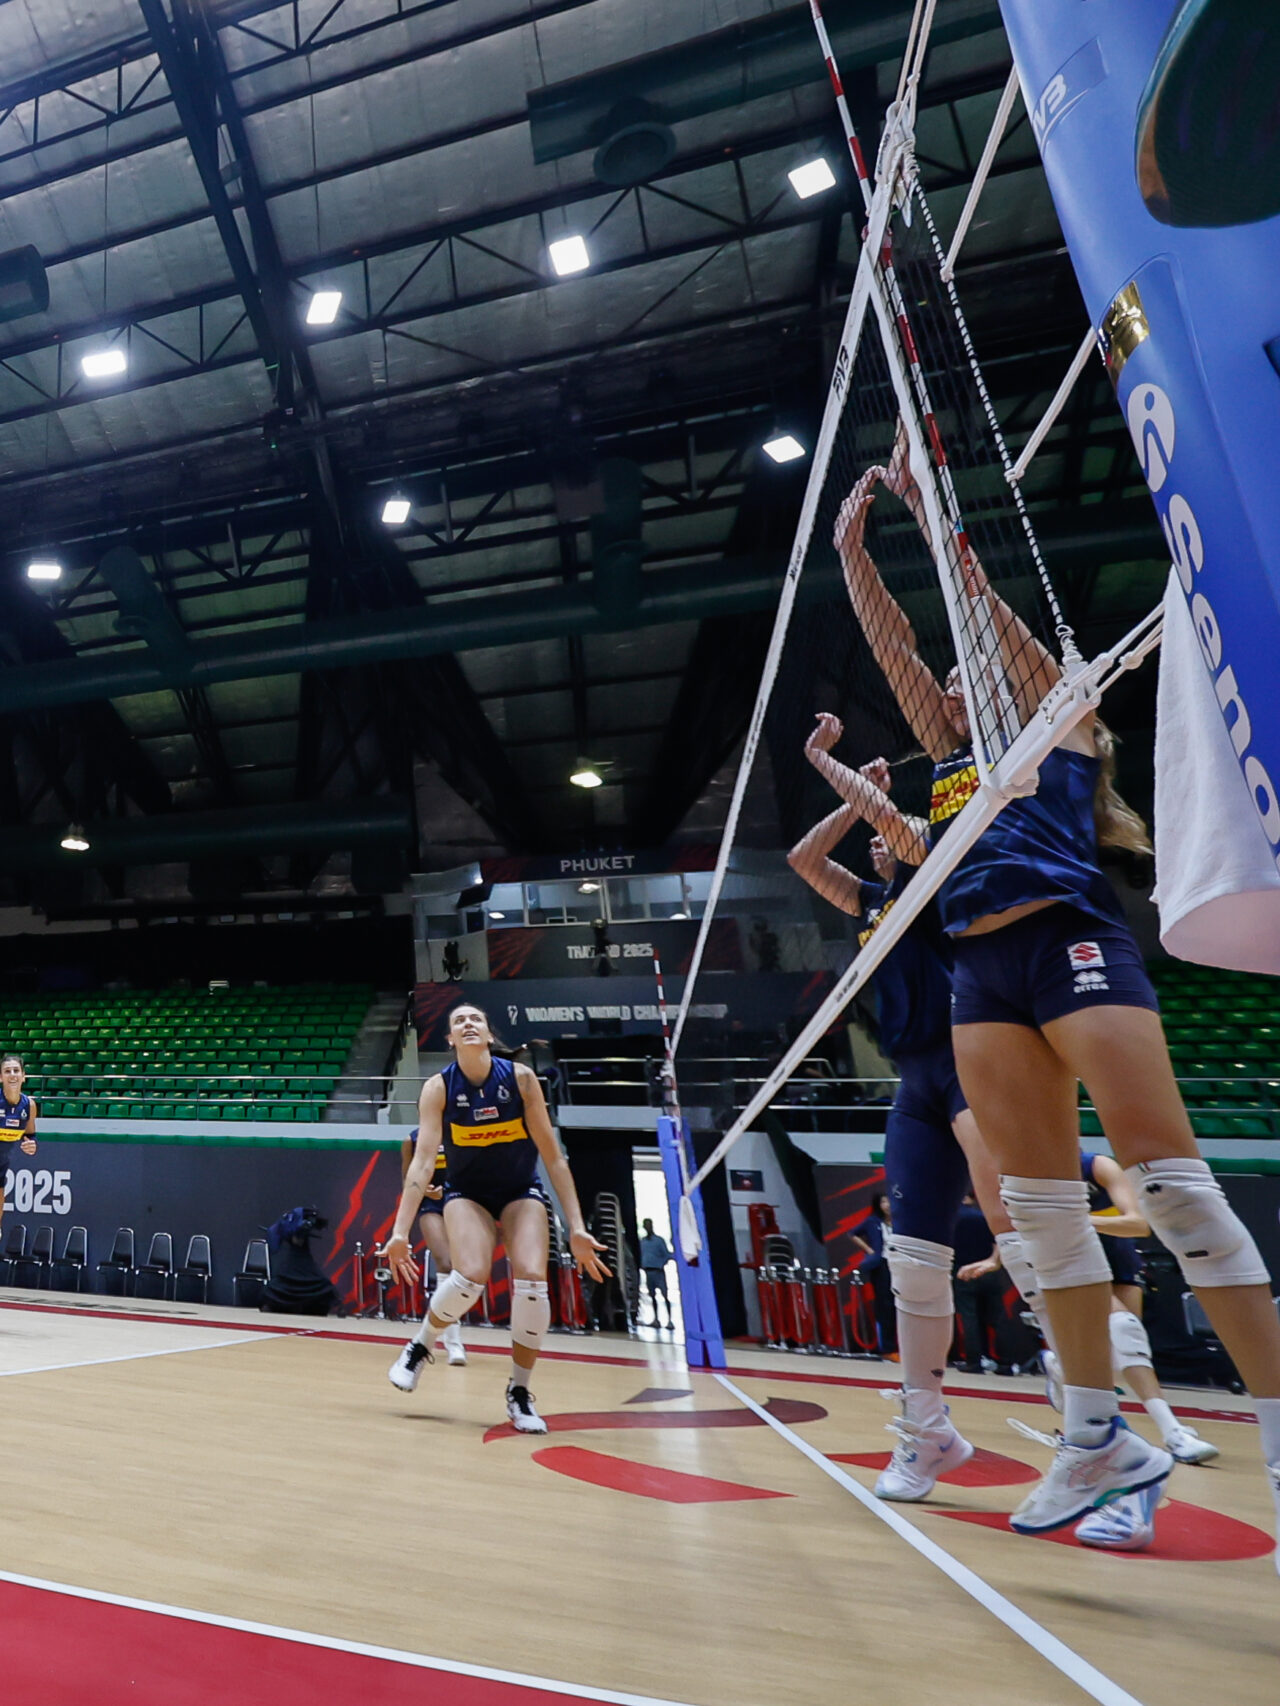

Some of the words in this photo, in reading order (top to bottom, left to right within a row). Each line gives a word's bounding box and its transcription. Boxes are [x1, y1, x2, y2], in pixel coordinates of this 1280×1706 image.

[561, 855, 635, 872] PHUKET
[468, 1130, 510, 1140] DHL
[3, 1169, 72, 1215] 2025
